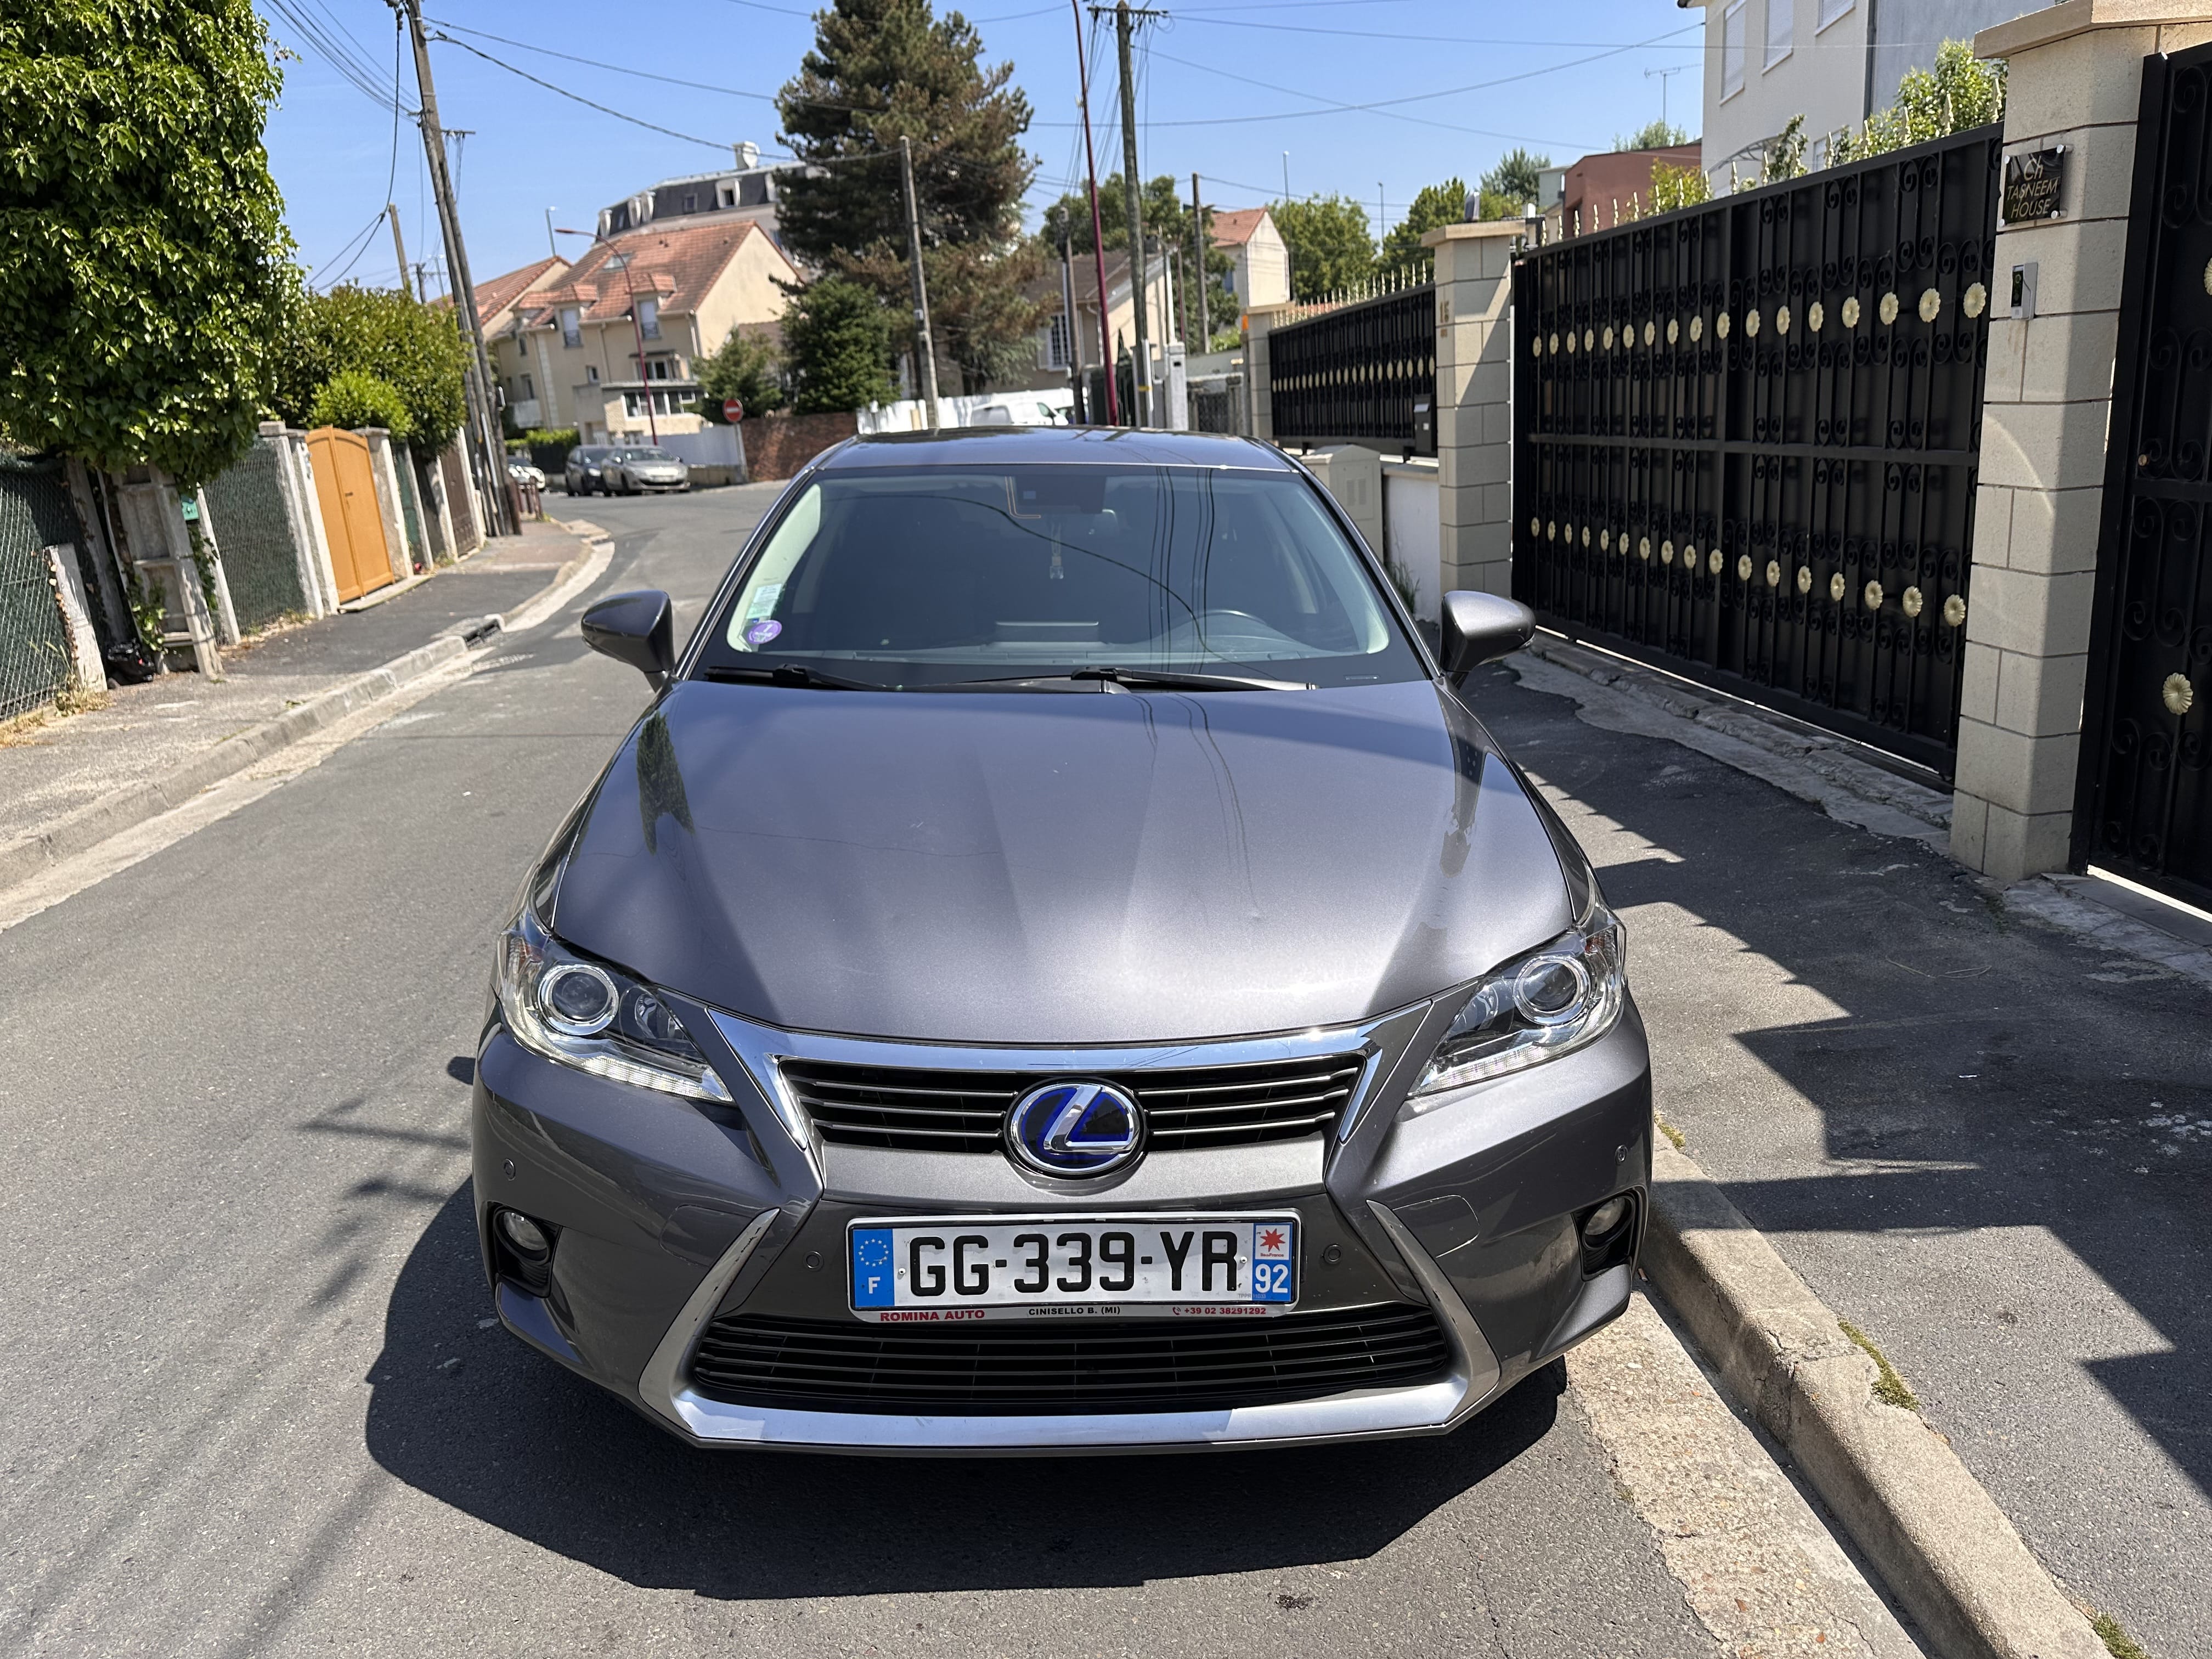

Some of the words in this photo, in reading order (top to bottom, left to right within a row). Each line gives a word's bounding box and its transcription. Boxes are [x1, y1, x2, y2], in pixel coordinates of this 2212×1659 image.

[2024, 155, 2044, 181] Ch
[2007, 177, 2058, 201] TASNEEM
[2011, 199, 2051, 218] HOUSE
[910, 1231, 1238, 1296] GG-339-YR
[868, 1277, 881, 1294] F
[1255, 1263, 1288, 1293] 92
[880, 1312, 939, 1322] ROMINA
[944, 1310, 985, 1319] AUTO
[1101, 1306, 1120, 1314] (MI)
